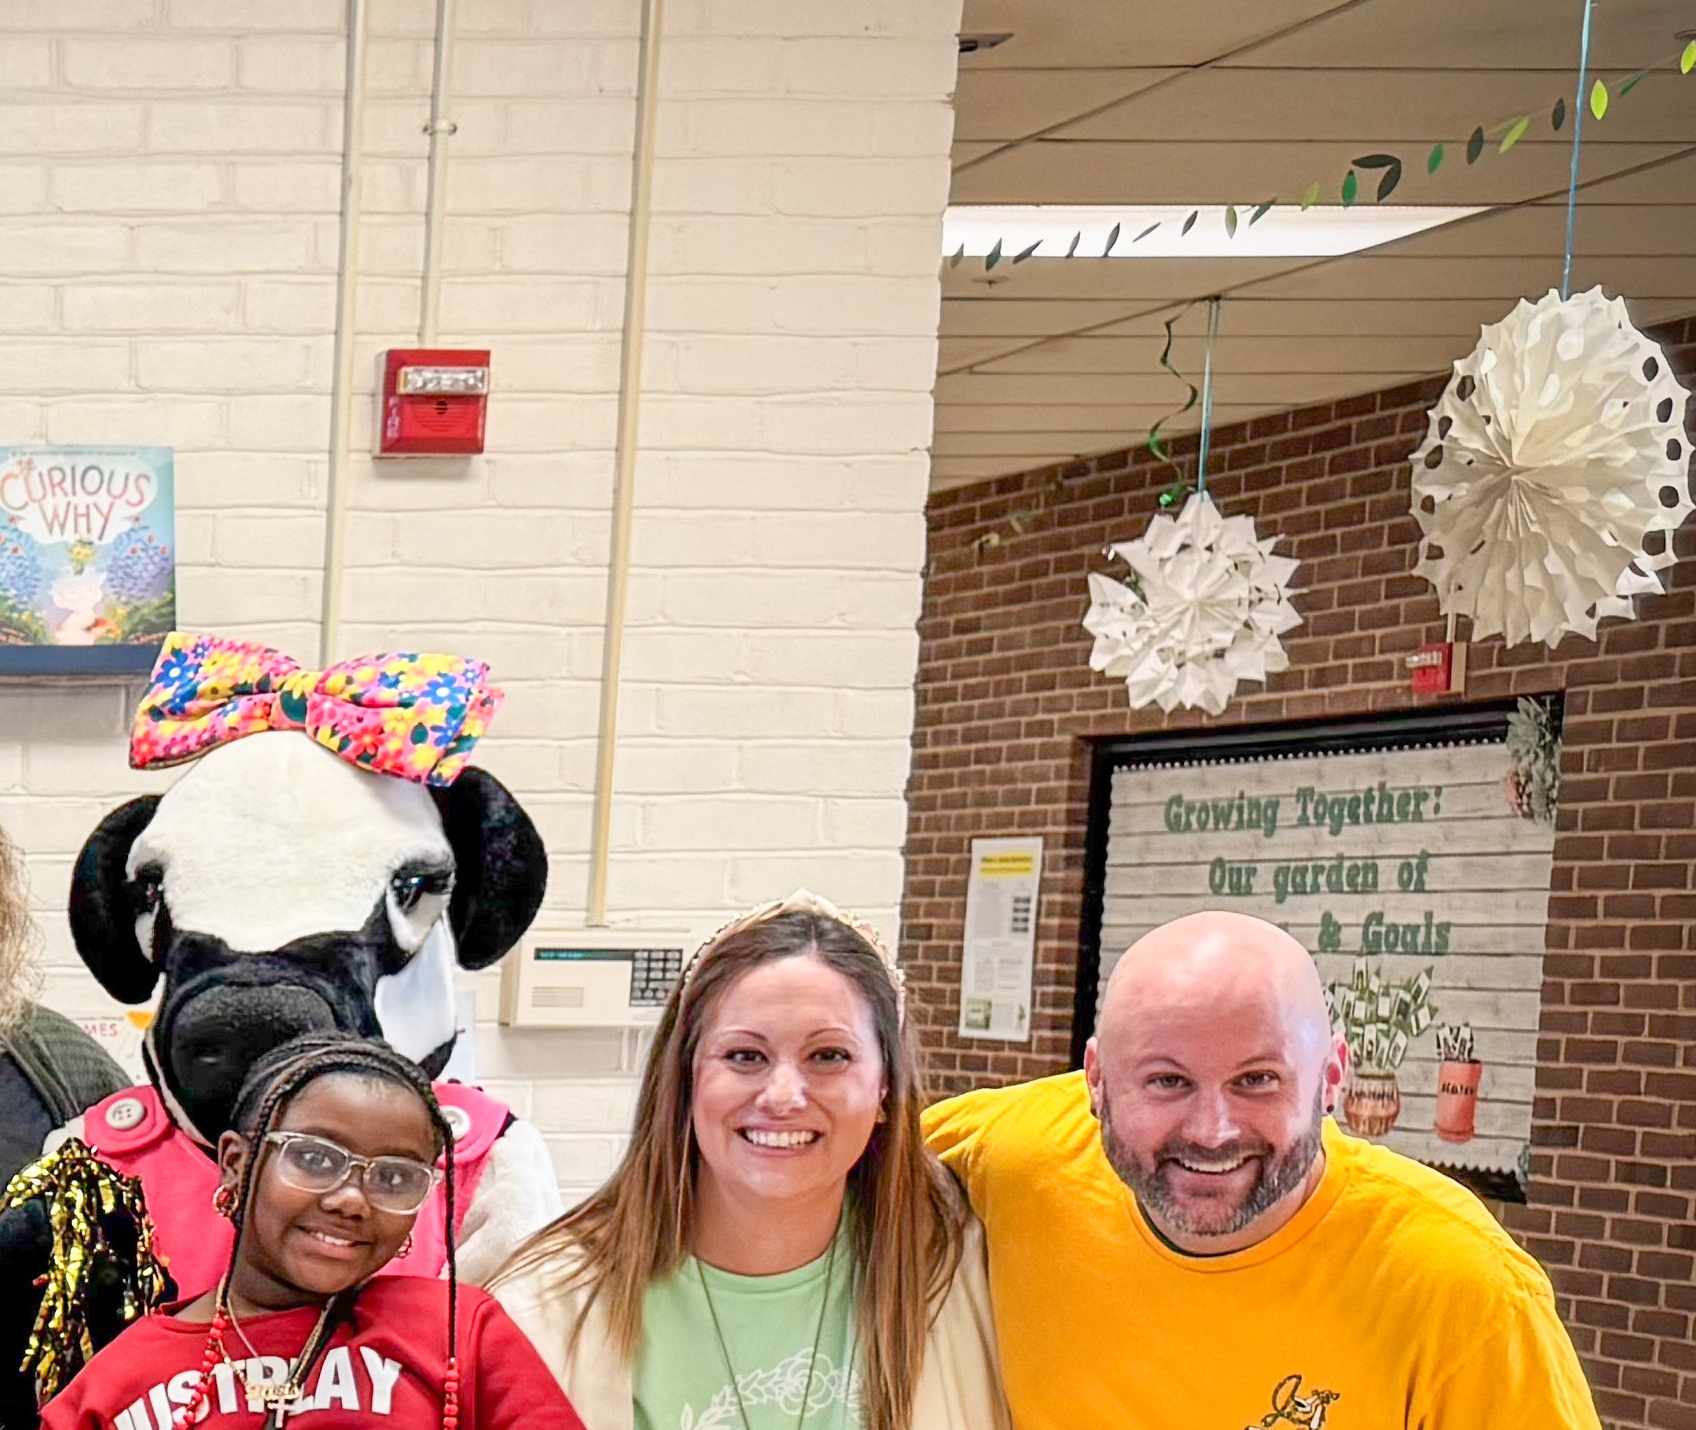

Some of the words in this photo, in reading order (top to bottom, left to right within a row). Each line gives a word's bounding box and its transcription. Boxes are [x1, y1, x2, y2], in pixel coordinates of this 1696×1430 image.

[0, 464, 151, 511] CURIOUS
[39, 500, 115, 541] WHY
[1164, 790, 1280, 838] Growing
[1294, 781, 1443, 837] Together:
[1209, 856, 1258, 896] Our
[1273, 852, 1379, 904] garden
[1397, 849, 1430, 893] of
[1318, 911, 1342, 952] &
[1362, 910, 1451, 956] Goals
